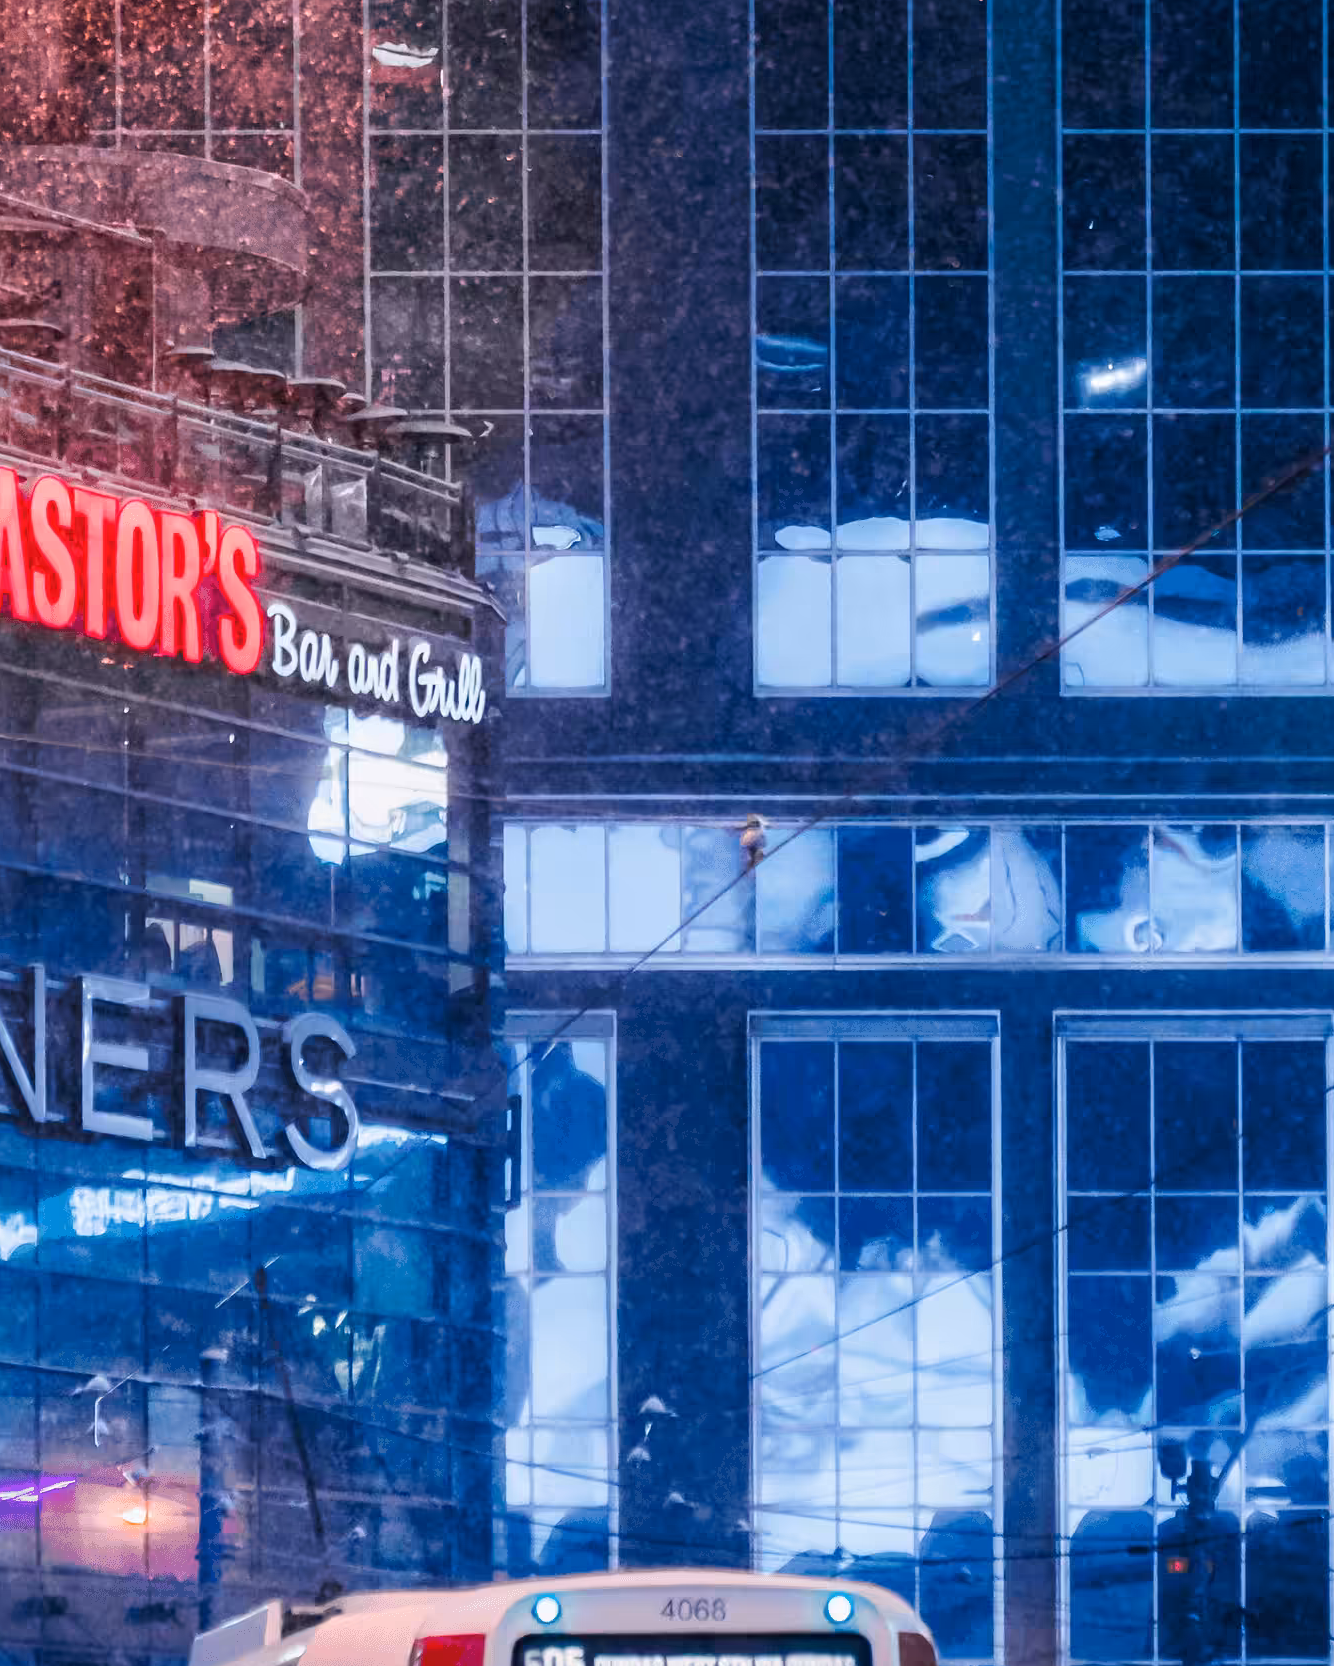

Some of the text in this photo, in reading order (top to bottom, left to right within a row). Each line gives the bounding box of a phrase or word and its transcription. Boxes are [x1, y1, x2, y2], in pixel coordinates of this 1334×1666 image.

[267, 603, 486, 725] Bar and Grill
[659, 1596, 728, 1621] 4068
